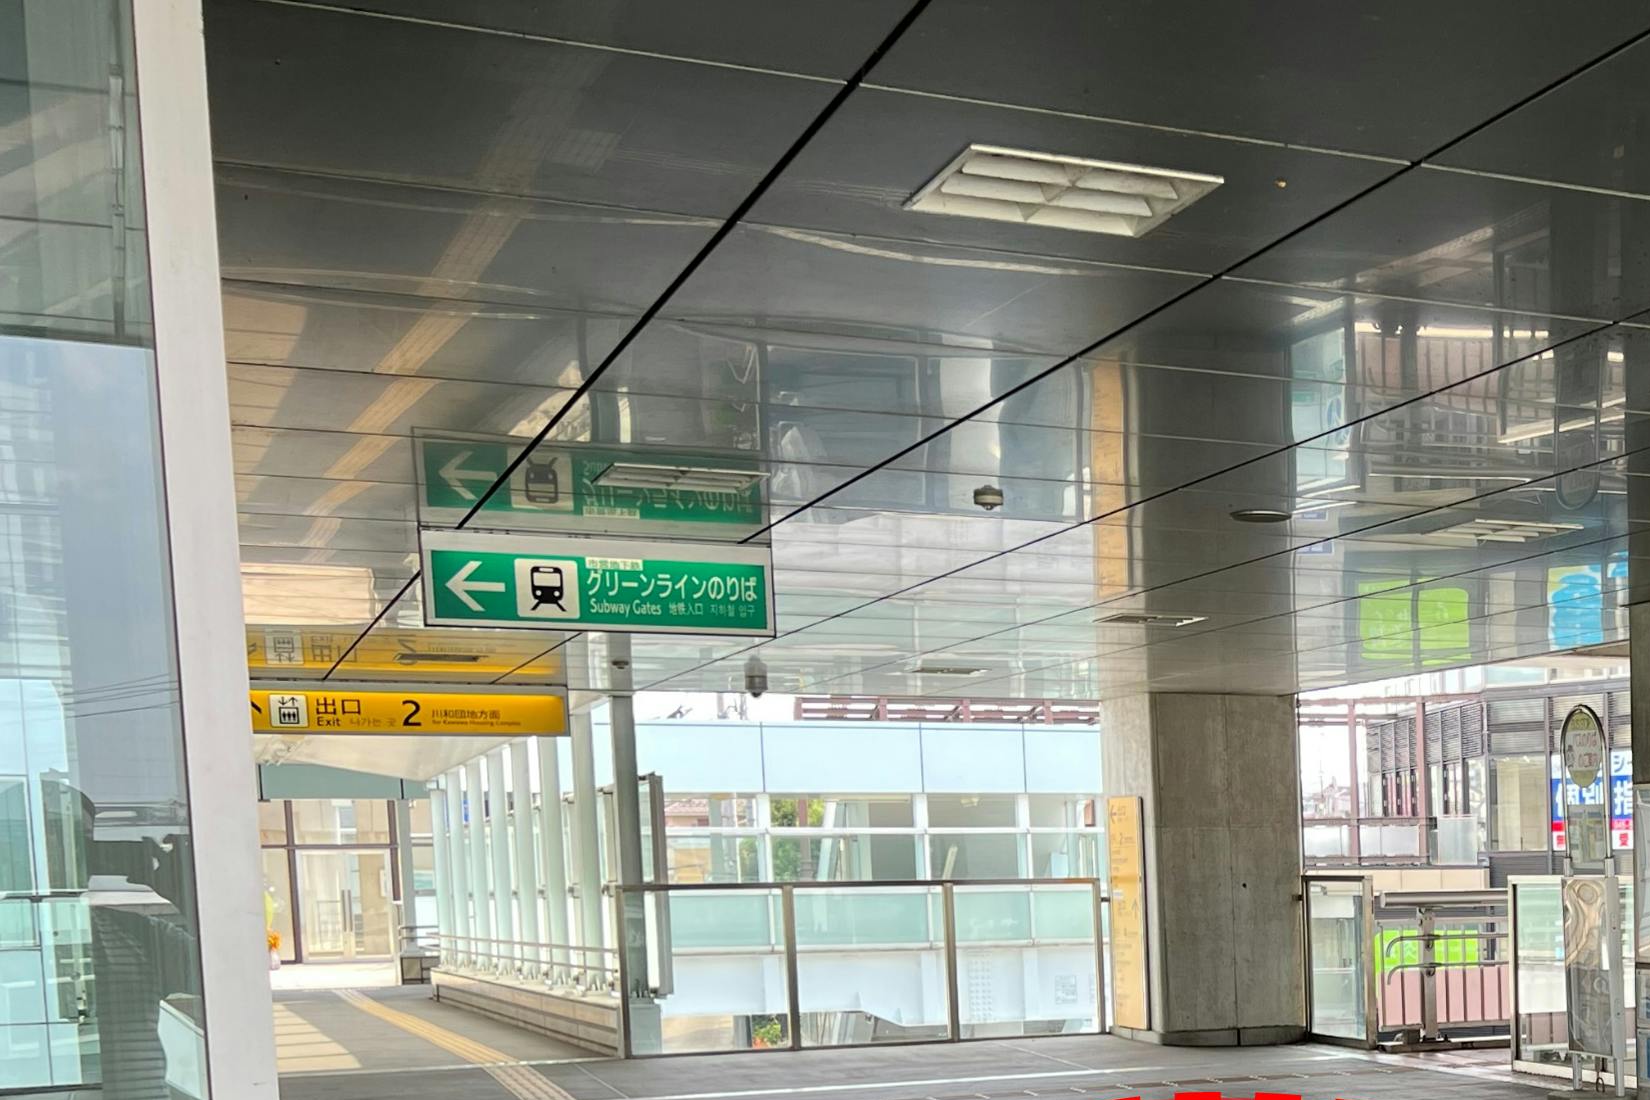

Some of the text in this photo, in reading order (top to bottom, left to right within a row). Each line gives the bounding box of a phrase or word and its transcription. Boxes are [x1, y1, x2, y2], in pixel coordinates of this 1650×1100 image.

[587, 570, 758, 602] グリーンラインのりば
[590, 598, 662, 618] Subway Gates
[315, 697, 362, 716] 出口
[402, 699, 422, 727] 2
[316, 716, 341, 727] Exit
